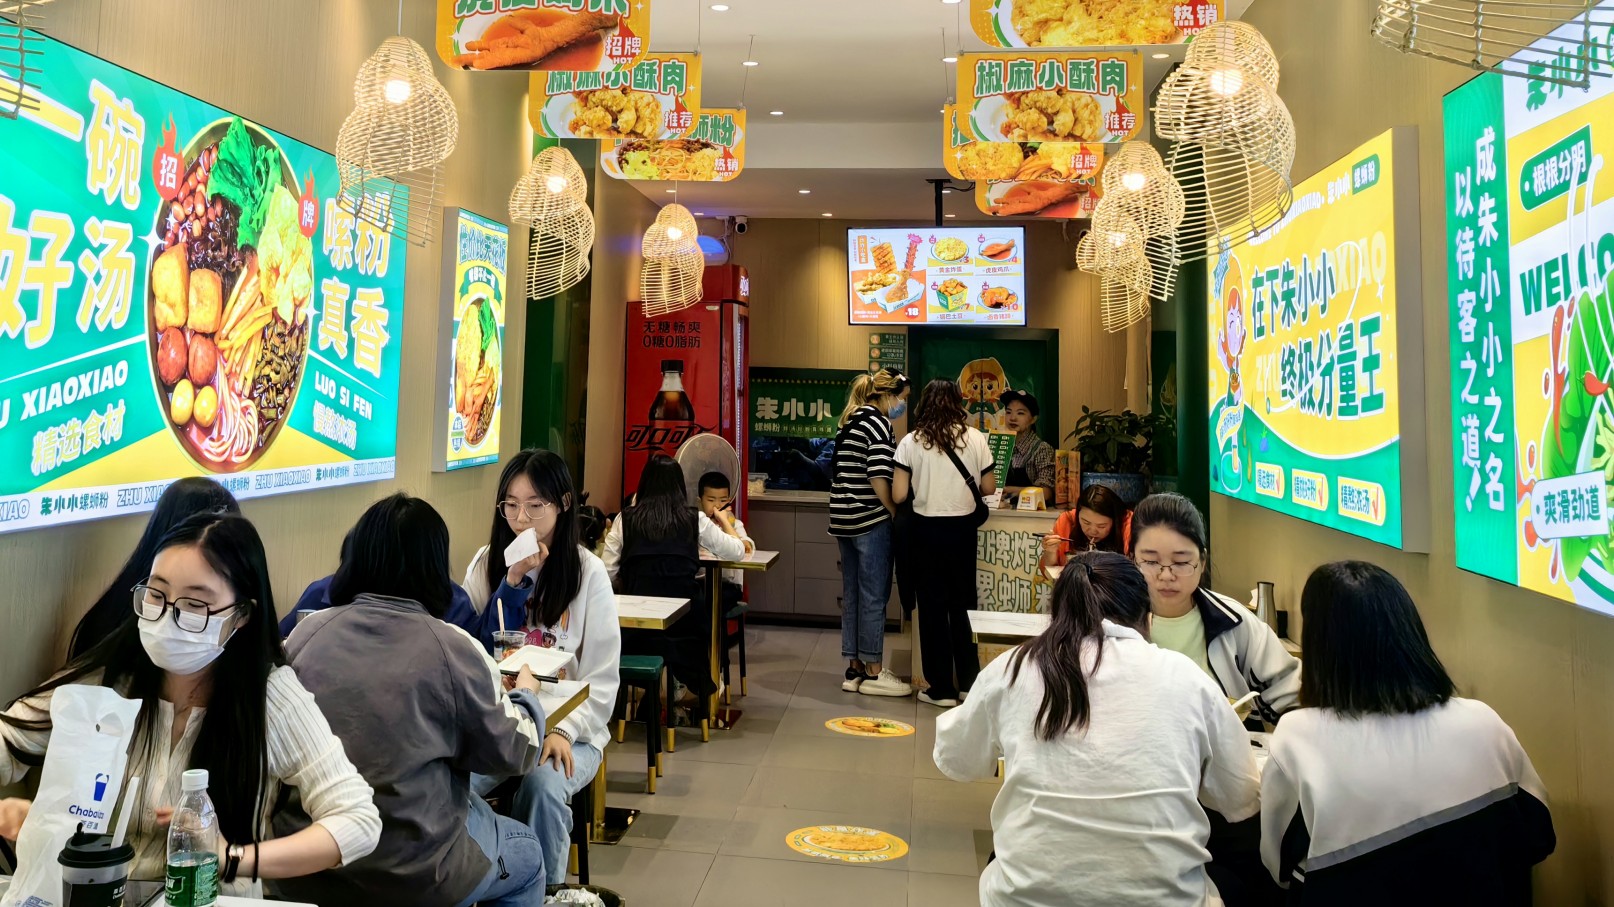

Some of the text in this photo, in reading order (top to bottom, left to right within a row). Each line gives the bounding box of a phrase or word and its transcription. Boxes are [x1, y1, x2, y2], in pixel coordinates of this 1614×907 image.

[1173, 4, 1218, 26] 热销
[1184, 28, 1201, 36] HO
[605, 36, 642, 56] 招牌
[974, 59, 1127, 97] 椒麻小酥肉
[664, 111, 693, 128] 推荐
[1104, 112, 1136, 130] 推荐
[159, 153, 178, 190] 招
[714, 158, 738, 171] 热销
[1071, 154, 1097, 168] 招牌
[1532, 140, 1587, 197] 根根分明
[1251, 249, 1337, 343] 在下朱小小
[318, 276, 391, 379] 真香
[643, 321, 701, 333] 无糖畅爽
[1476, 125, 1505, 512] 成朱小小之名
[643, 336, 700, 348] 0糖0脂肪
[1279, 312, 1385, 420] 终极分量王
[20, 360, 128, 422] XIAOXIAO
[315, 371, 373, 421] LUO SI FEN
[755, 397, 832, 421] 朱小小
[30, 399, 126, 477] 精选食材
[626, 424, 717, 450] 可口可
[255, 469, 311, 490] ZHU XIAOXIAO
[40, 491, 109, 516] 朱小小螺蛳粉
[117, 487, 143, 507] ZHU
[1543, 485, 1601, 525] 爽滑劲道
[977, 530, 1043, 575] 牌炸
